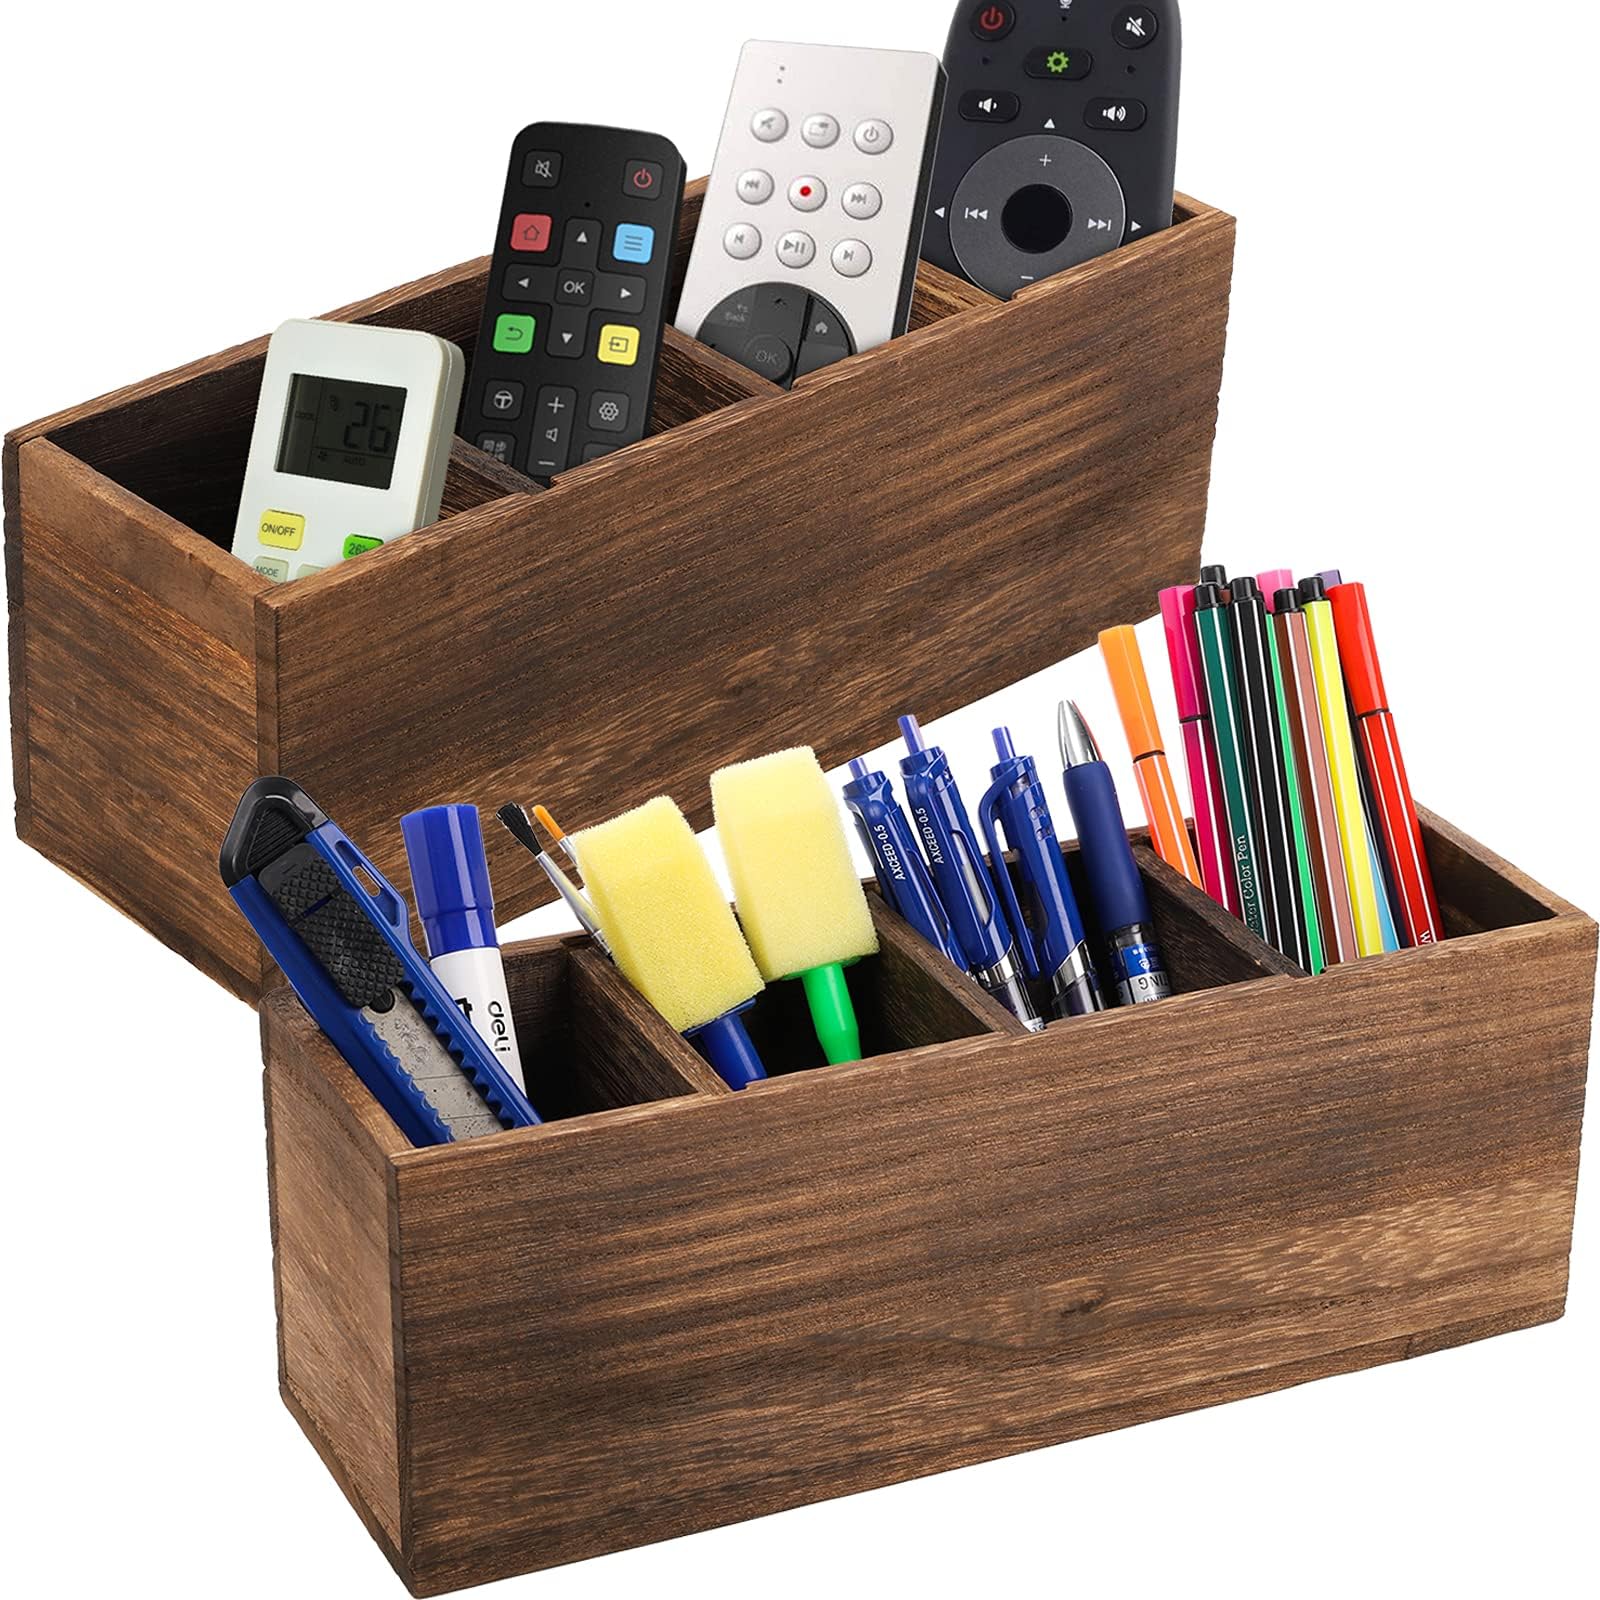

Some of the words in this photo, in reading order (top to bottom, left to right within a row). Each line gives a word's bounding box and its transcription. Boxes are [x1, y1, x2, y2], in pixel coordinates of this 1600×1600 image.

[563, 280, 585, 295] OK
[755, 350, 778, 365] OK
[343, 401, 392, 453] 26
[261, 522, 296, 537] ON/OFF
[1236, 835, 1249, 862] Pen
[1241, 865, 1255, 899] Color
[487, 1000, 511, 1052] deli
